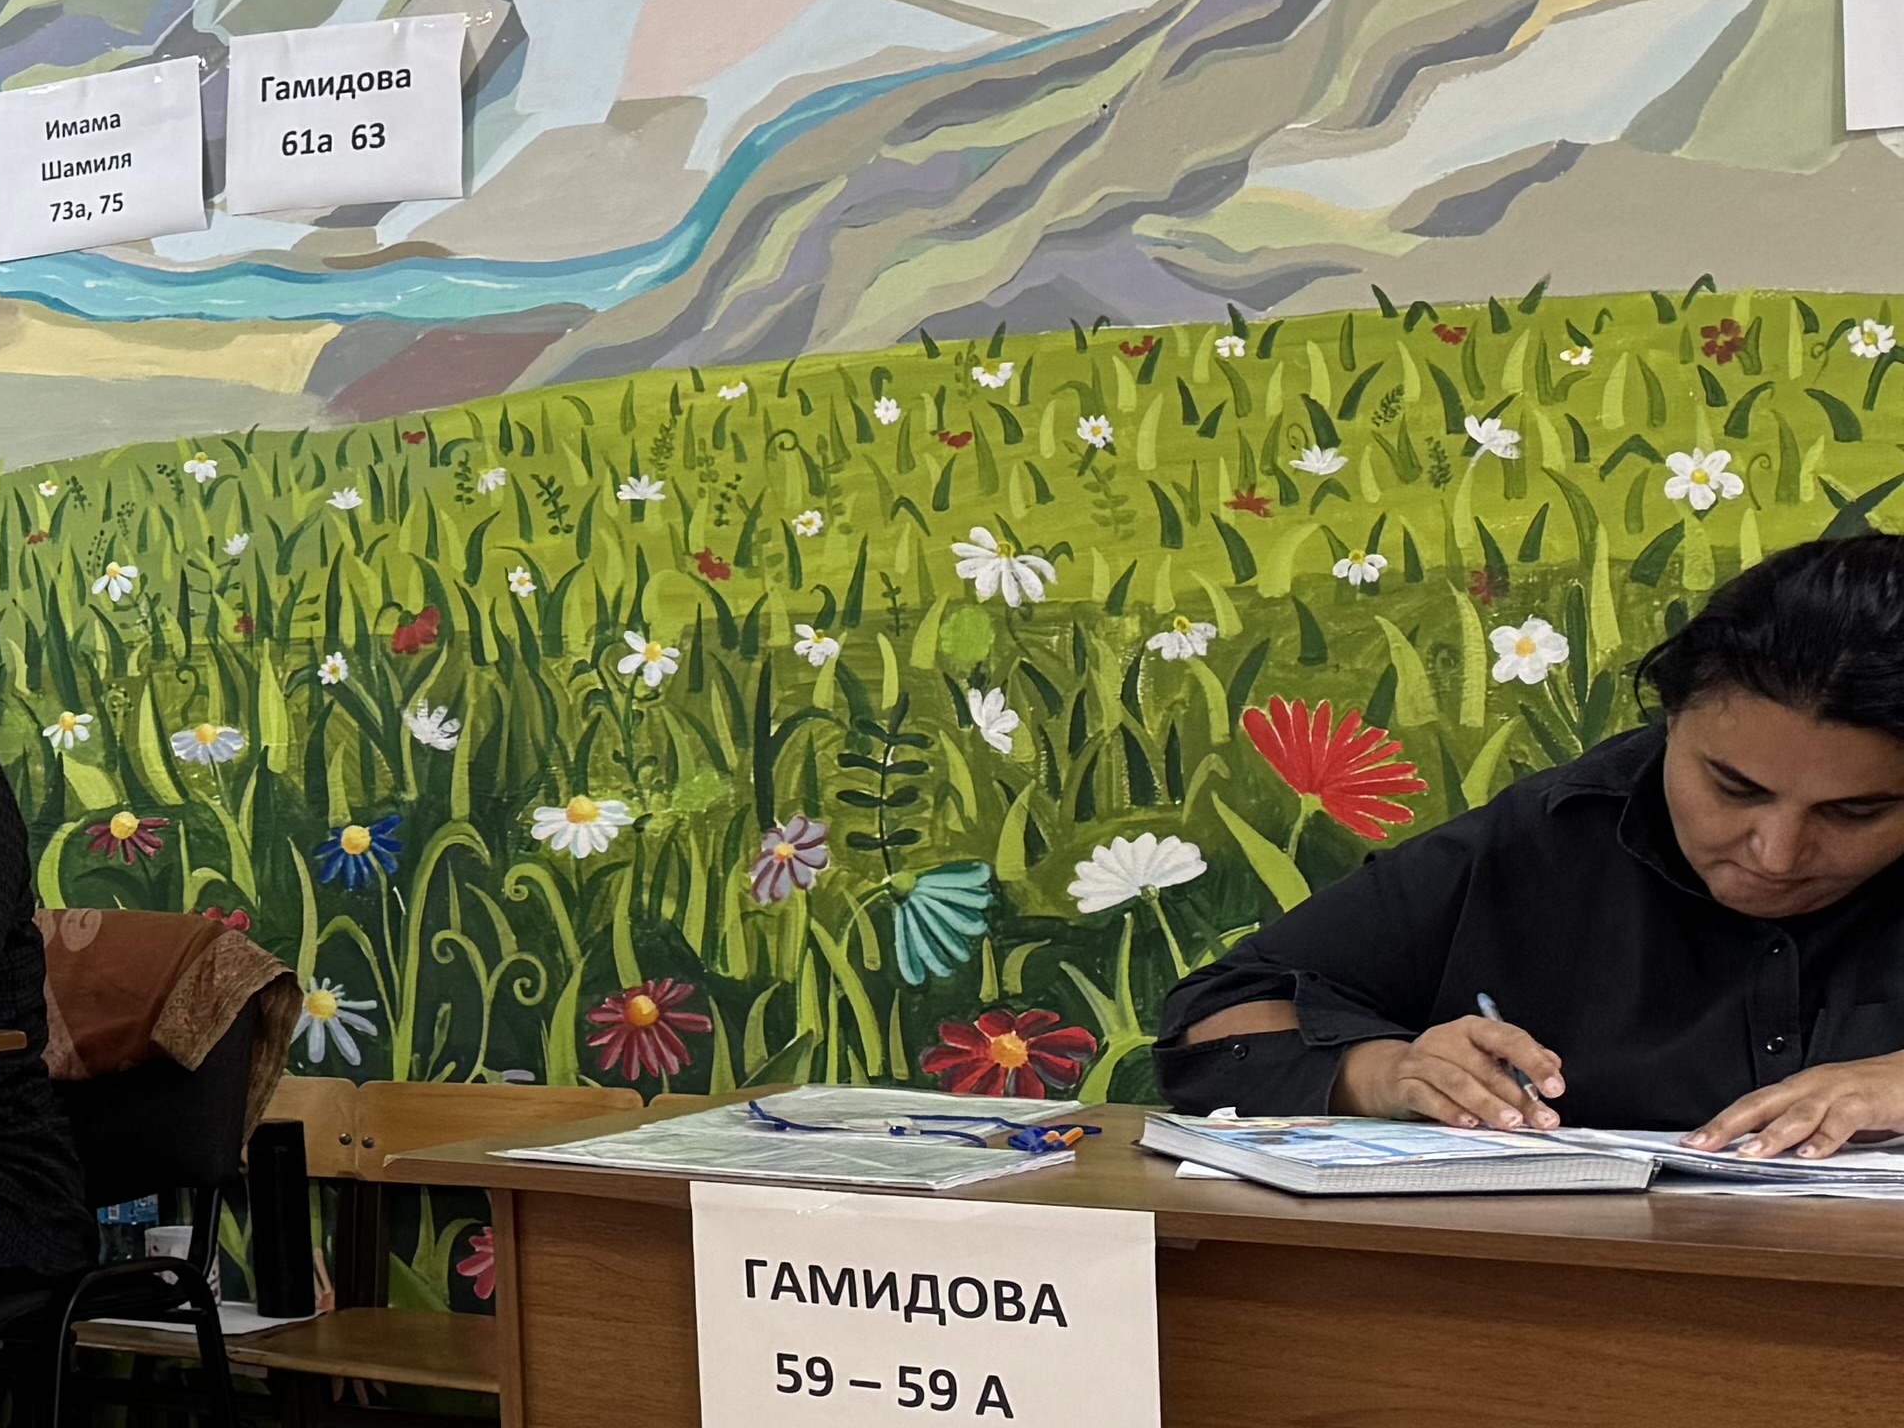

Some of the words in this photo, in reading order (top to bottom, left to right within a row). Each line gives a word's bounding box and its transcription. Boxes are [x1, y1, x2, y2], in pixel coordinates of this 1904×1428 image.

[261, 68, 411, 103] Гамидова
[45, 113, 121, 141] Имама
[281, 128, 333, 157] 61а
[351, 122, 386, 151] 63
[41, 152, 132, 182] Шамиля
[49, 200, 93, 223] 73а,
[99, 192, 124, 215] 75
[744, 1258, 1068, 1328] ГАМИДОВА
[776, 1352, 834, 1397] 59
[897, 1365, 958, 1412] 59
[975, 1374, 1014, 1419] А
